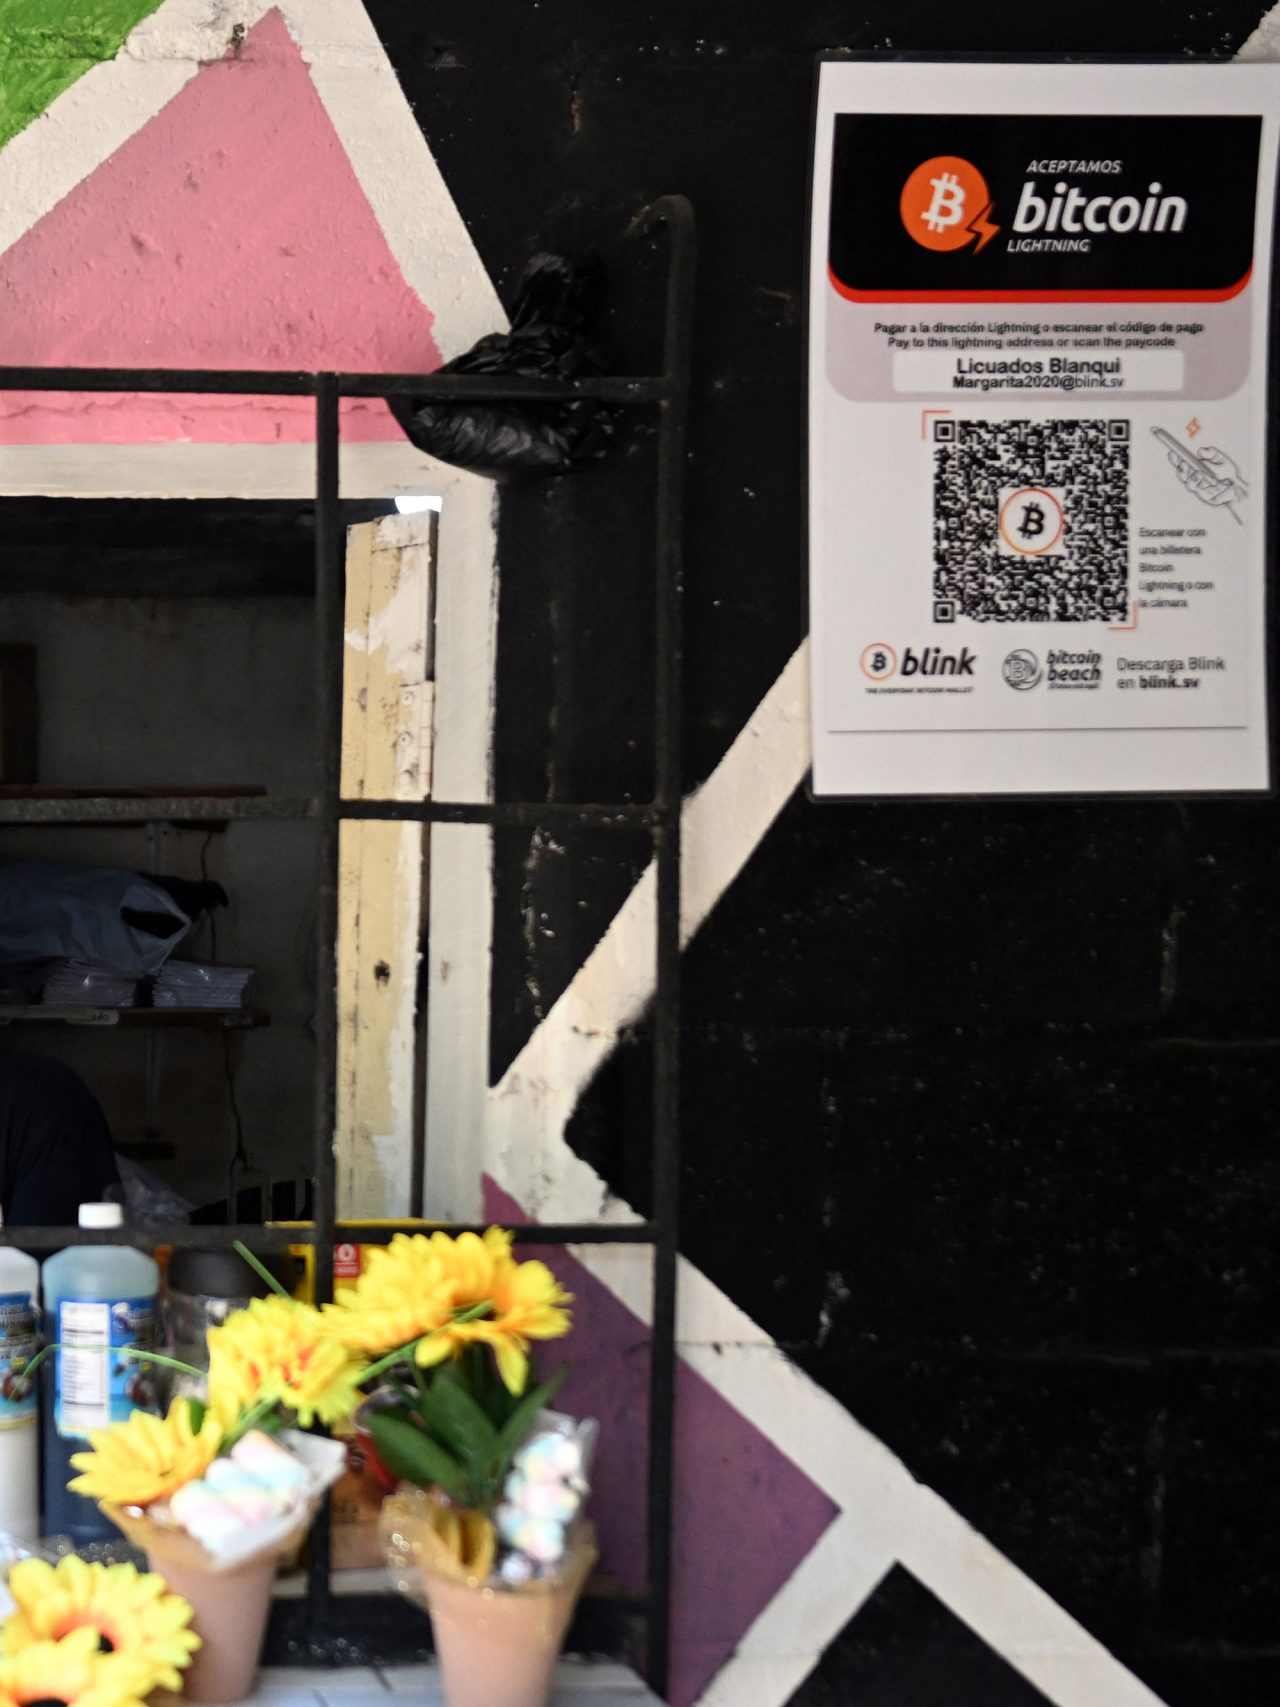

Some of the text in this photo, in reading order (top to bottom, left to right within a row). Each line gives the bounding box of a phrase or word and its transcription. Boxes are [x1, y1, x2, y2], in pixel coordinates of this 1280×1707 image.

[1026, 160, 1123, 173] ACEPTAMOS
[1012, 181, 1188, 233] bitcoin
[1007, 239, 1091, 252] LIGHTNING
[874, 323, 906, 335] Pagar
[910, 325, 917, 333] a
[920, 323, 929, 333] la
[932, 322, 984, 333] dirección
[987, 322, 1040, 335] Lightning
[1052, 324, 1103, 333] escanear
[1106, 322, 1116, 332] el
[1119, 321, 1156, 334] código
[1159, 322, 1173, 332] de
[1176, 323, 1204, 335] pago
[888, 336, 1176, 349] Pay to this lightning address or scan the paycode
[957, 357, 1121, 376] Licuados Blanqui
[952, 375, 1124, 391] Margarita2020@blink.sv
[901, 647, 977, 676] blink
[1047, 649, 1102, 664] bitcoin
[1047, 664, 1101, 681] beach
[1117, 657, 1226, 673] Descarga Blink
[1117, 675, 1200, 689] en blink.sv
